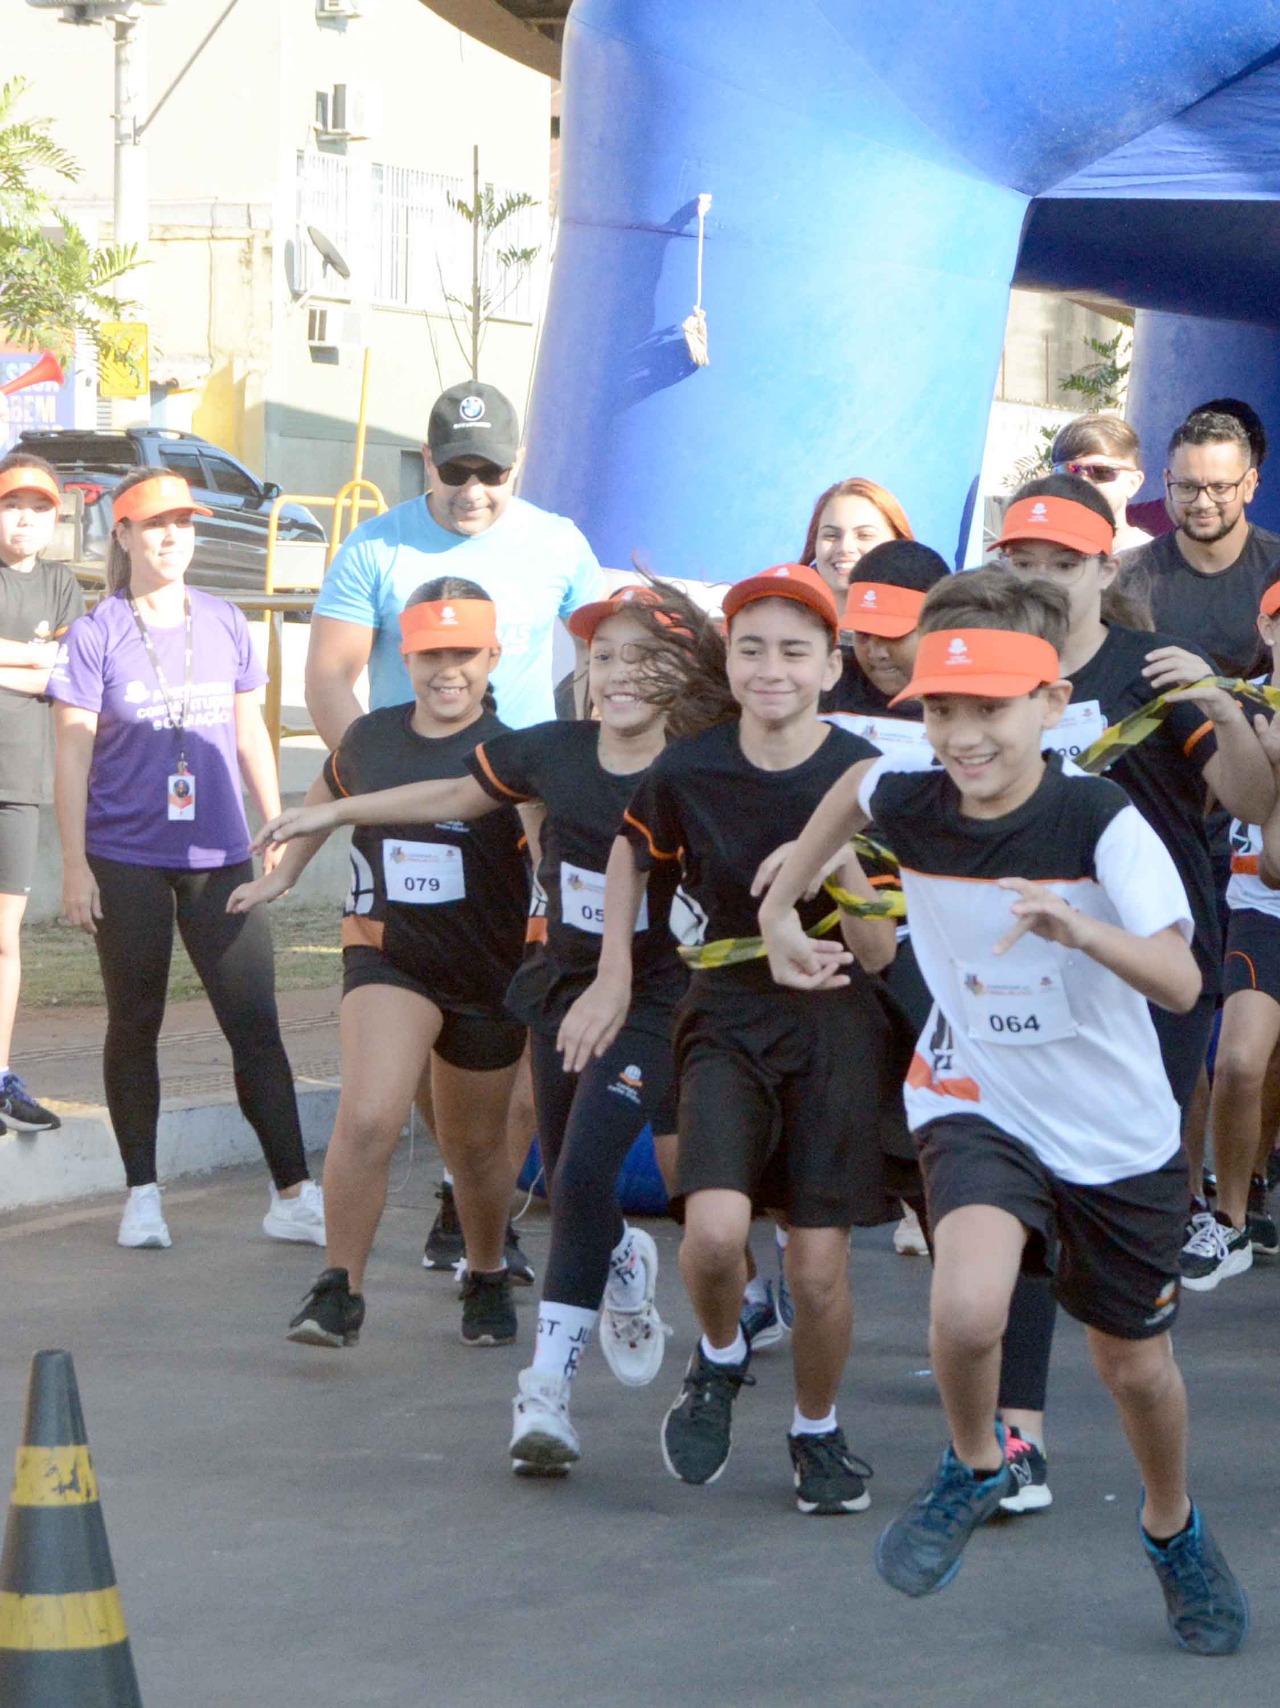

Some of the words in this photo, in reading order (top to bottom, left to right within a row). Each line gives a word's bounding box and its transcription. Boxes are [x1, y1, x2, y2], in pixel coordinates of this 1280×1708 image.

[404, 877, 440, 892] 079
[581, 906, 604, 922] 05
[989, 1014, 1040, 1033] 064
